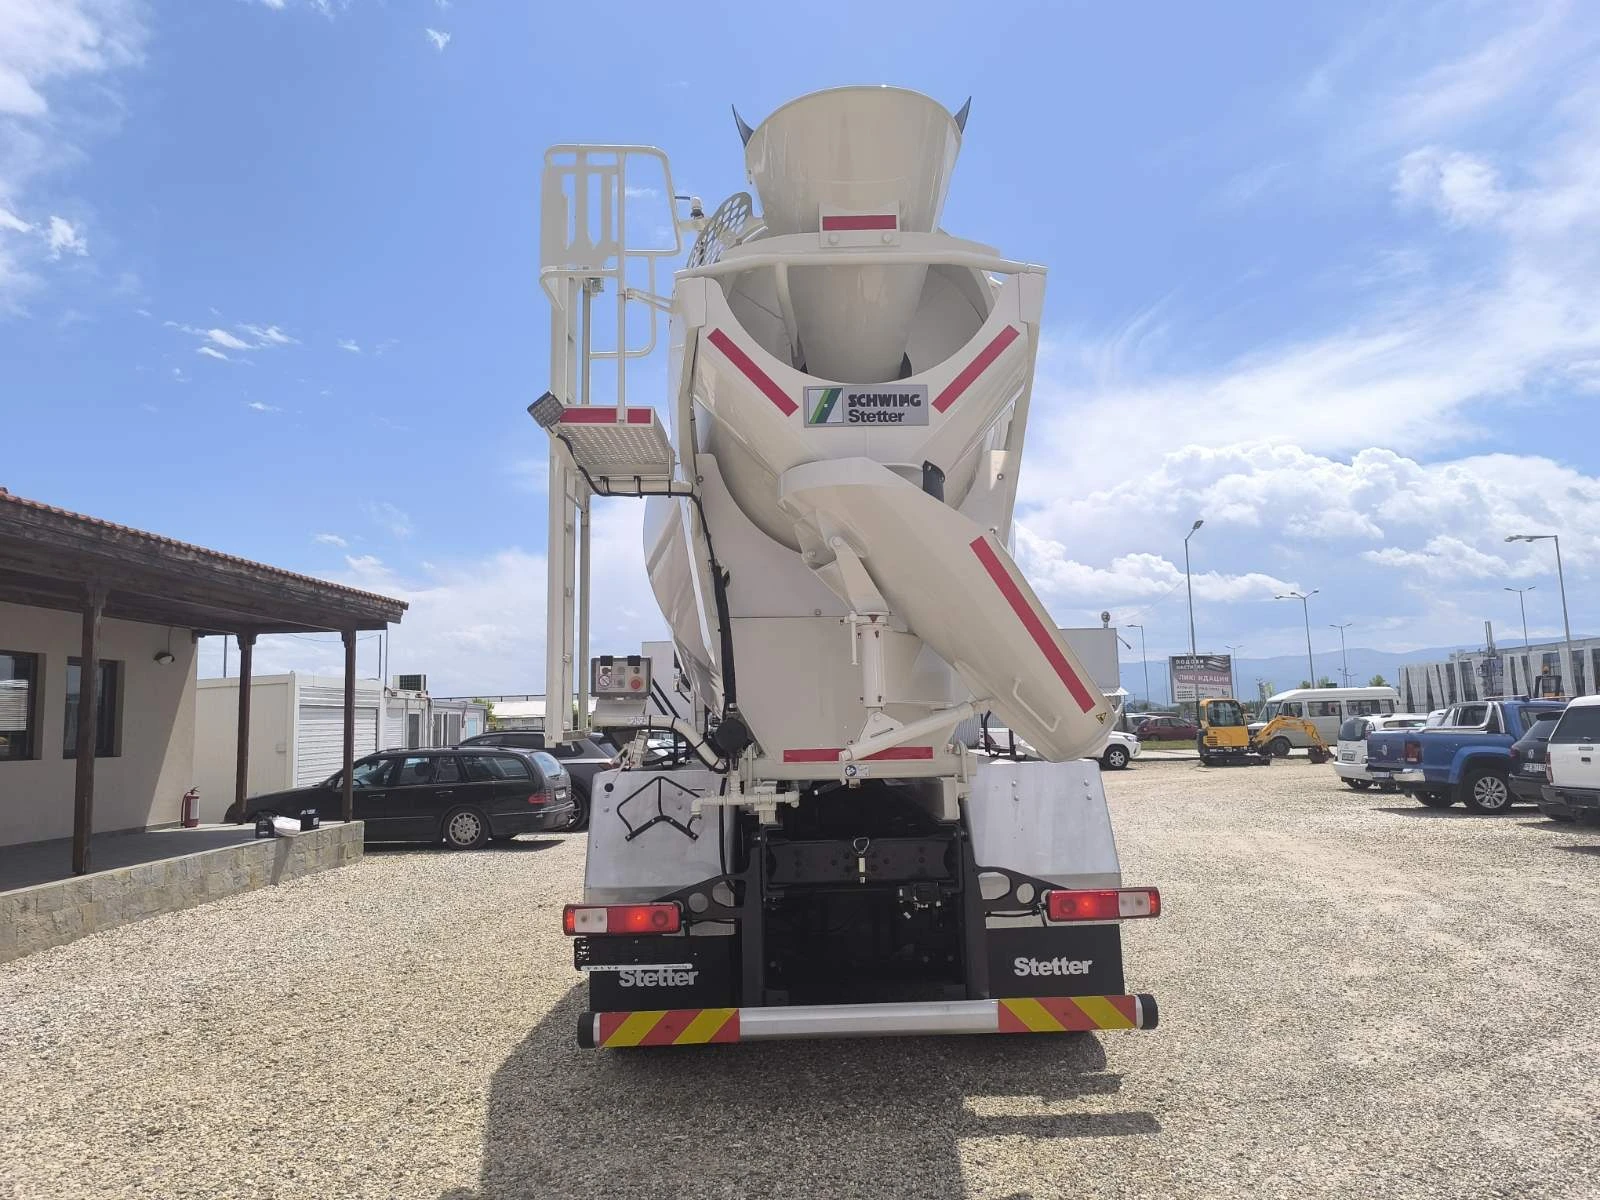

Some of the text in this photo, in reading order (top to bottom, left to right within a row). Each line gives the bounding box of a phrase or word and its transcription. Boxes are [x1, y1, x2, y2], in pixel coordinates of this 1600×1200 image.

[848, 394, 922, 407] SCHWING
[848, 409, 905, 423] Stetter
[1178, 674, 1229, 682] ЛИКИДАЦИЯ
[1014, 956, 1093, 976] Stetter
[619, 969, 699, 987] Stetter
